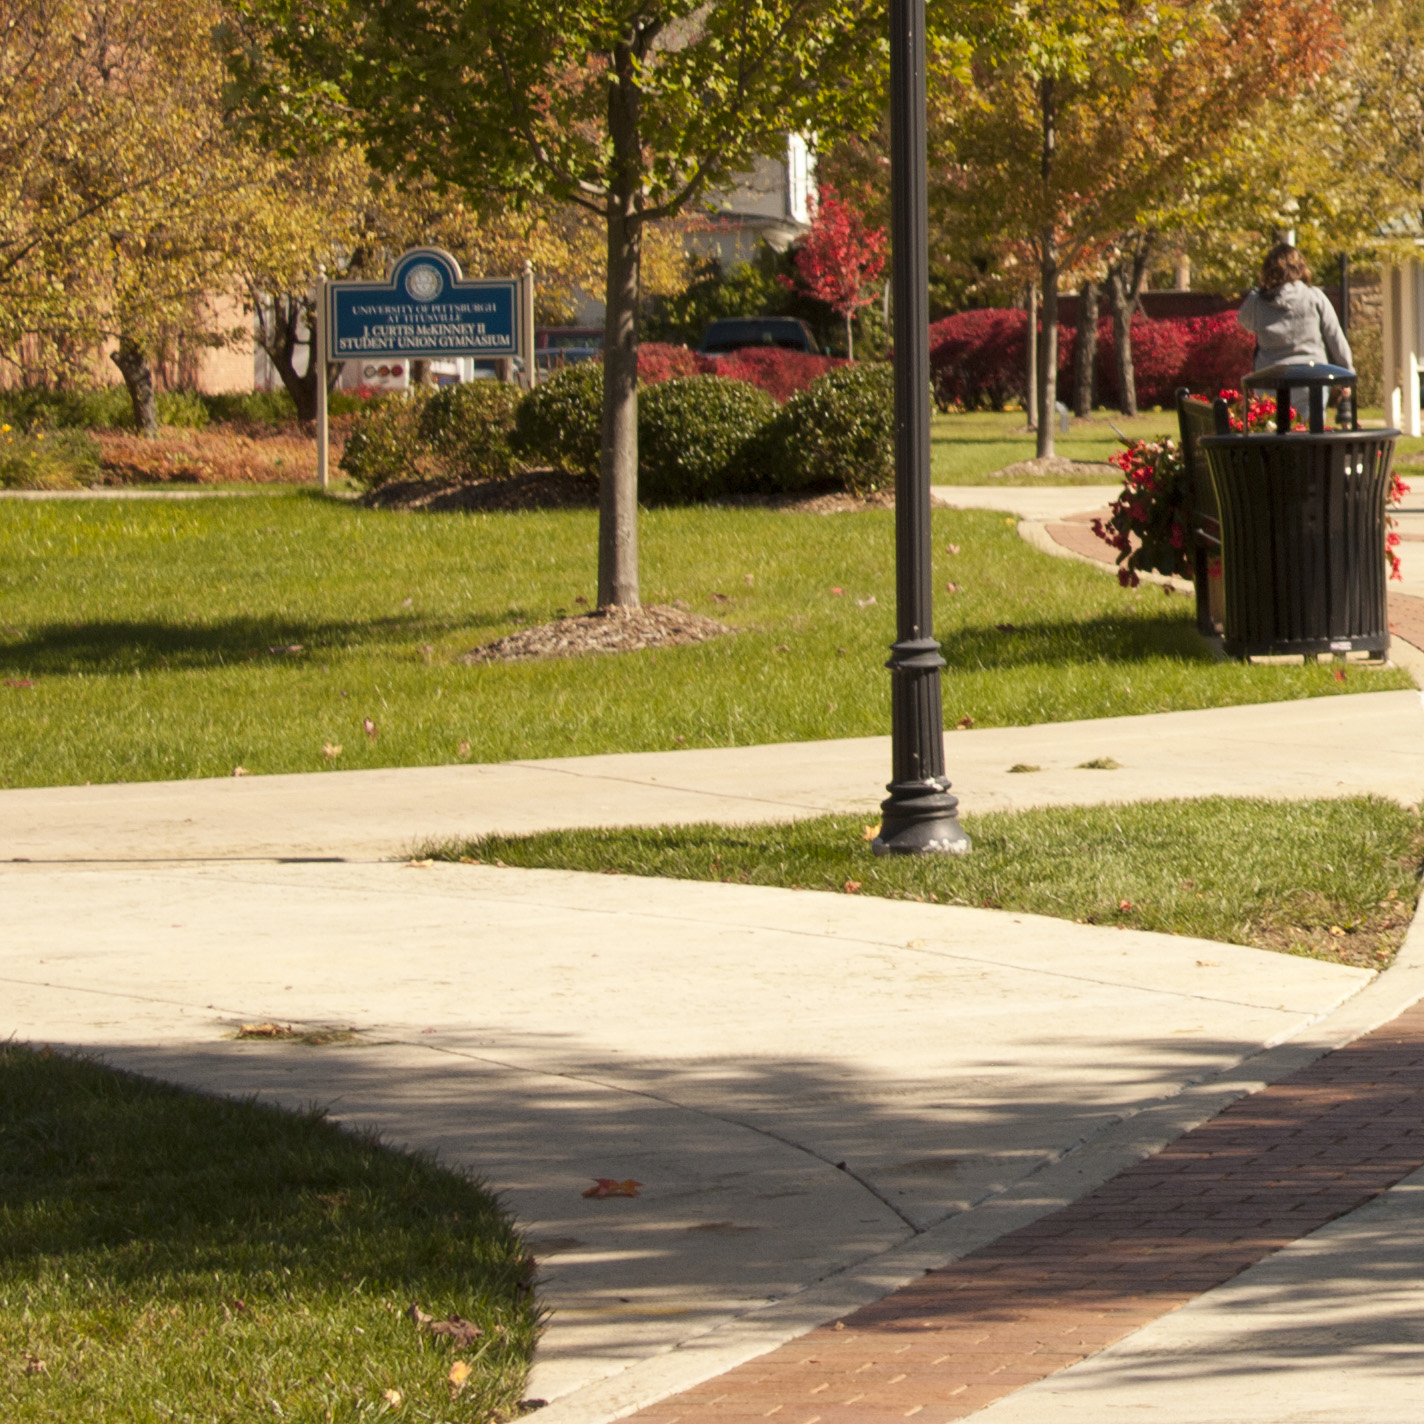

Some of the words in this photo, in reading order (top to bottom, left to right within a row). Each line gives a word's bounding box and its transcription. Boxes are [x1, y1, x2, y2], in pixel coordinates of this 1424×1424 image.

[352, 305, 413, 315] UNIVERSITY
[415, 305, 429, 313] OF
[431, 303, 497, 313] PITTSBURGH
[387, 315, 400, 323] AT
[404, 314, 462, 323] TITUSVILLE
[371, 325, 415, 336] CURTIS
[416, 324, 475, 335] McKINNEY
[477, 323, 486, 334] II
[339, 337, 395, 350] STUDENT
[398, 336, 437, 348] UNION
[438, 334, 511, 347] GYMNASIUM
